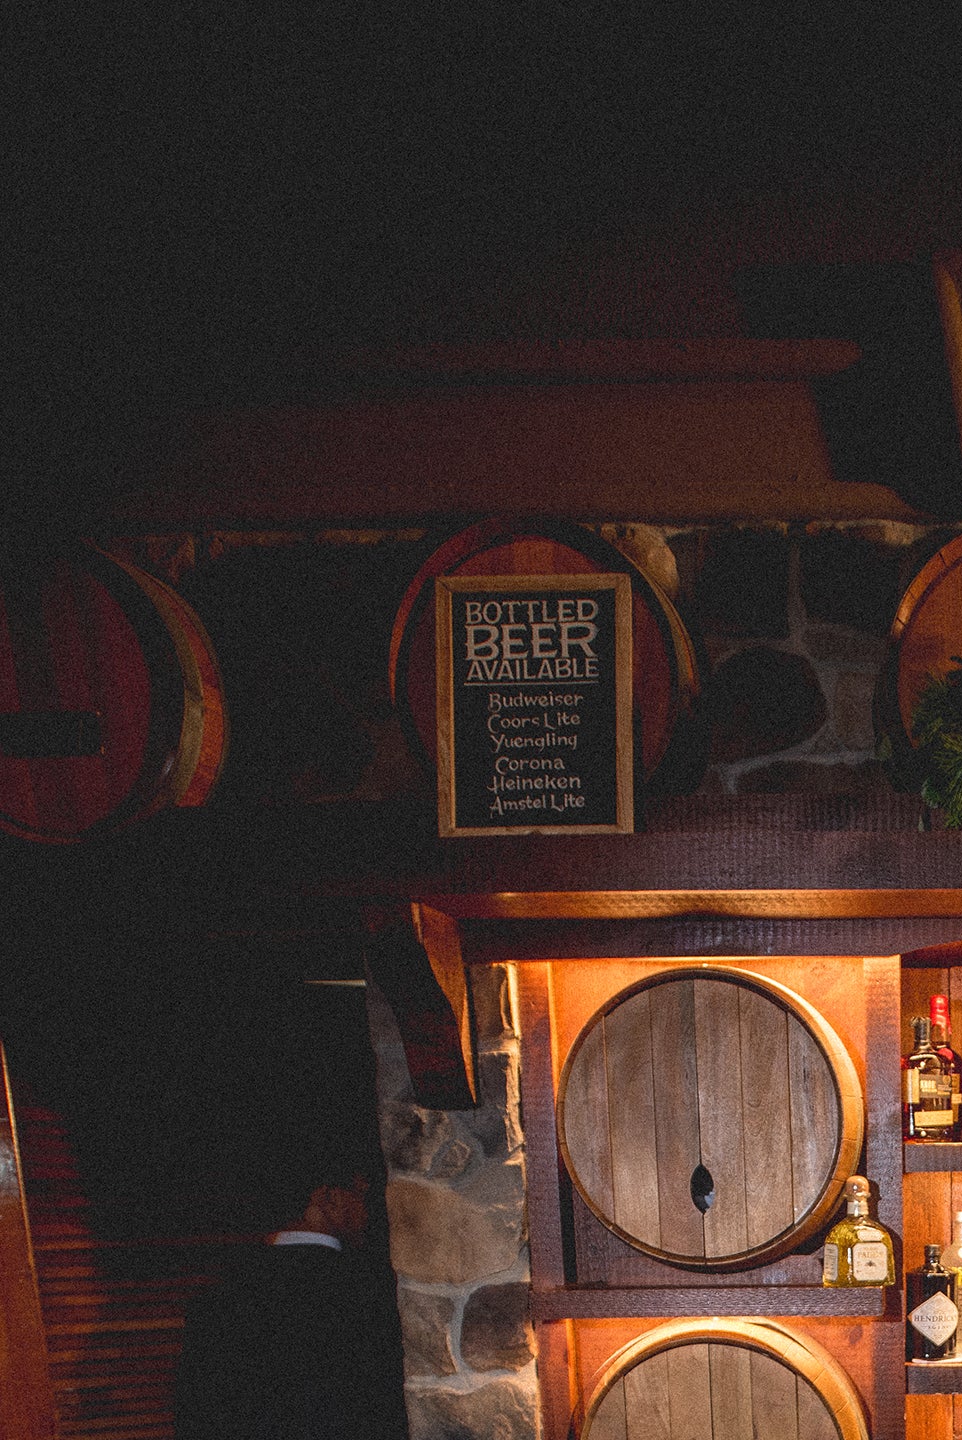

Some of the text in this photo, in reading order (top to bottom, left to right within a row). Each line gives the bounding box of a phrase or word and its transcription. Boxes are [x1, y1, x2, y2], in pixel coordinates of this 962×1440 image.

[464, 599, 600, 625] BOTTLED
[464, 621, 600, 661] BEER
[466, 658, 600, 681] AVAILABLE
[488, 691, 583, 712] Budweiser
[488, 712, 581, 735] Coors Lite
[490, 733, 577, 753] Yuengling
[494, 756, 566, 776] Corona
[486, 774, 582, 794] Heineken
[489, 793, 585, 818] Amstel Lite
